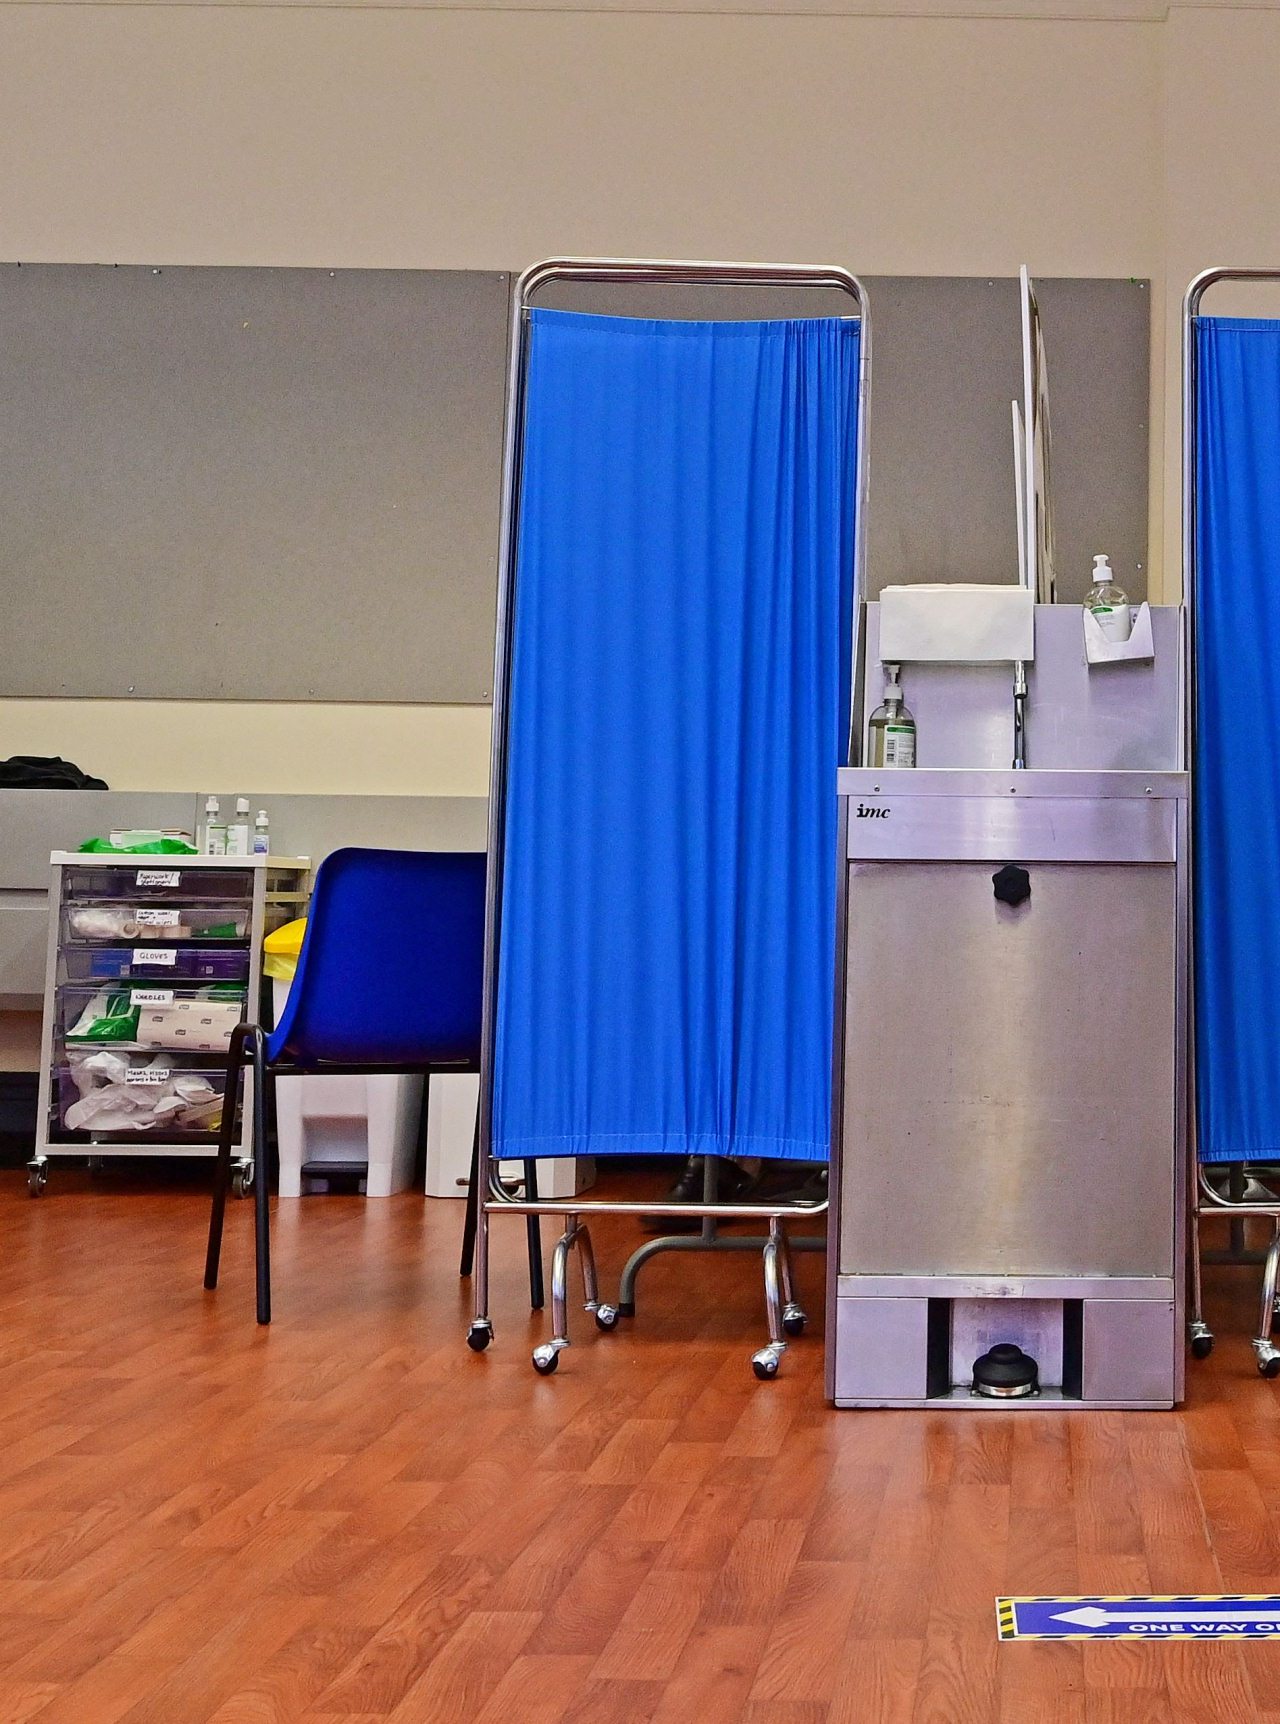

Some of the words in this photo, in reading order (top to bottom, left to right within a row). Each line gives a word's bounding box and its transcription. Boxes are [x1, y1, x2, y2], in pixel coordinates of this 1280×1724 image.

[856, 803, 891, 819] imc
[140, 952, 169, 960] GLOVES
[1128, 1624, 1185, 1632] ONE
[1190, 1623, 1248, 1632] WAY
